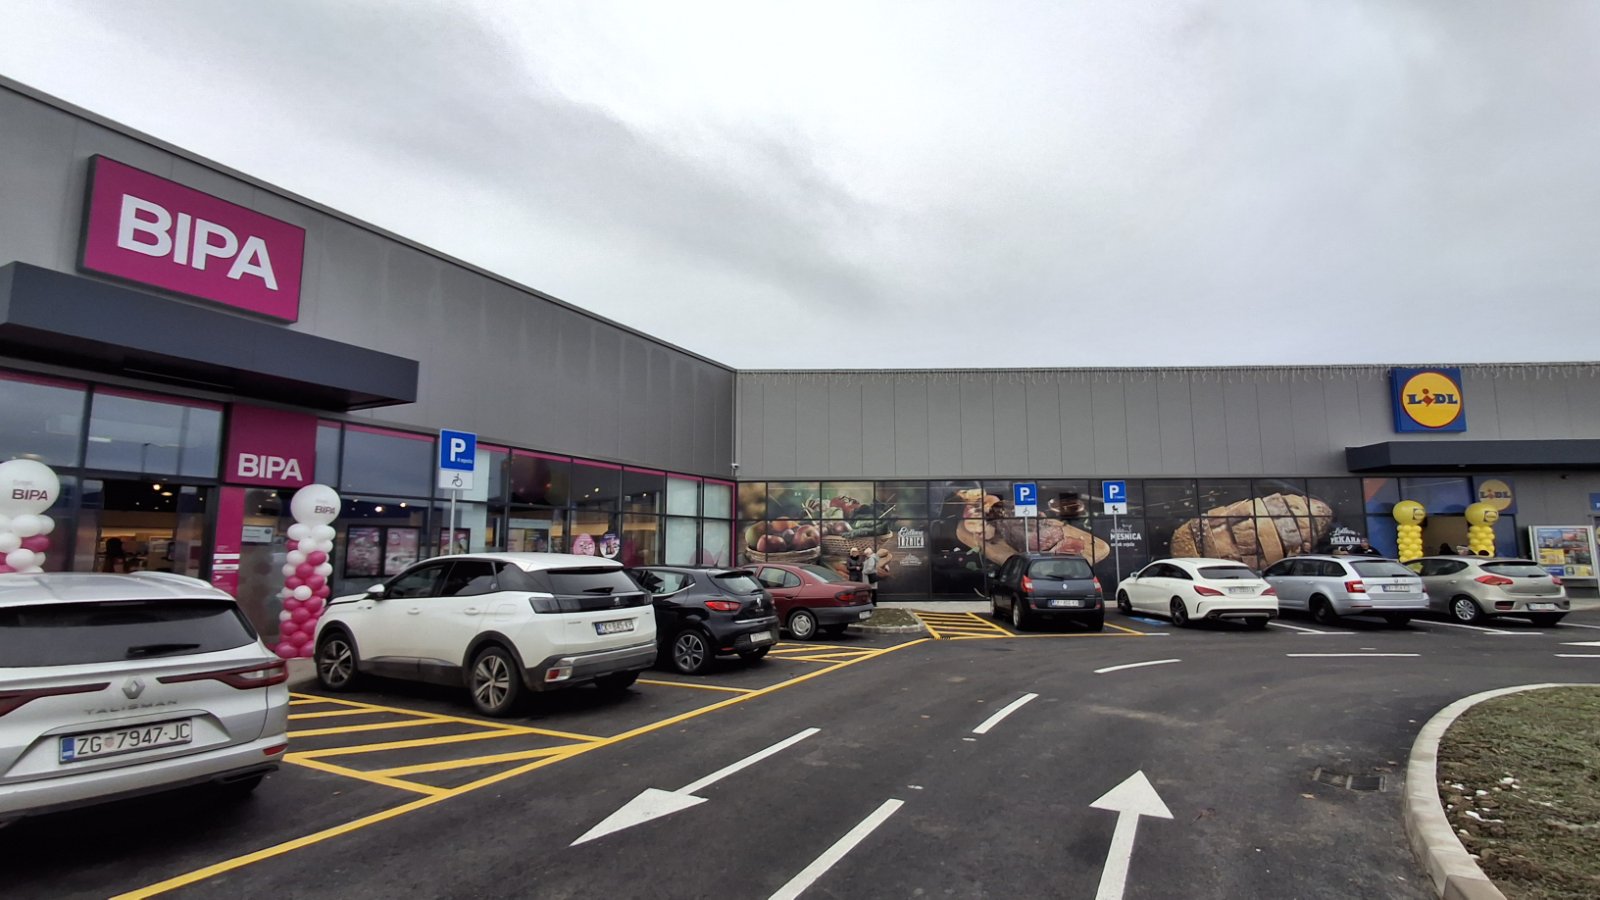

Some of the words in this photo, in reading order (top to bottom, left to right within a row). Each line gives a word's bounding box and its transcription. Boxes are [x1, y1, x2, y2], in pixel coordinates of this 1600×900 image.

[117, 194, 279, 291] BIPA
[1406, 388, 1458, 407] LIDL
[450, 437, 466, 462] P
[238, 453, 303, 481] BIPA
[12, 489, 48, 501] BIPA
[1020, 487, 1030, 501] P
[1109, 485, 1120, 499] P
[1479, 489, 1511, 499] LIDL
[314, 505, 336, 514] BIPA
[84, 700, 178, 715] TALISMAN
[77, 736, 102, 756] ZG
